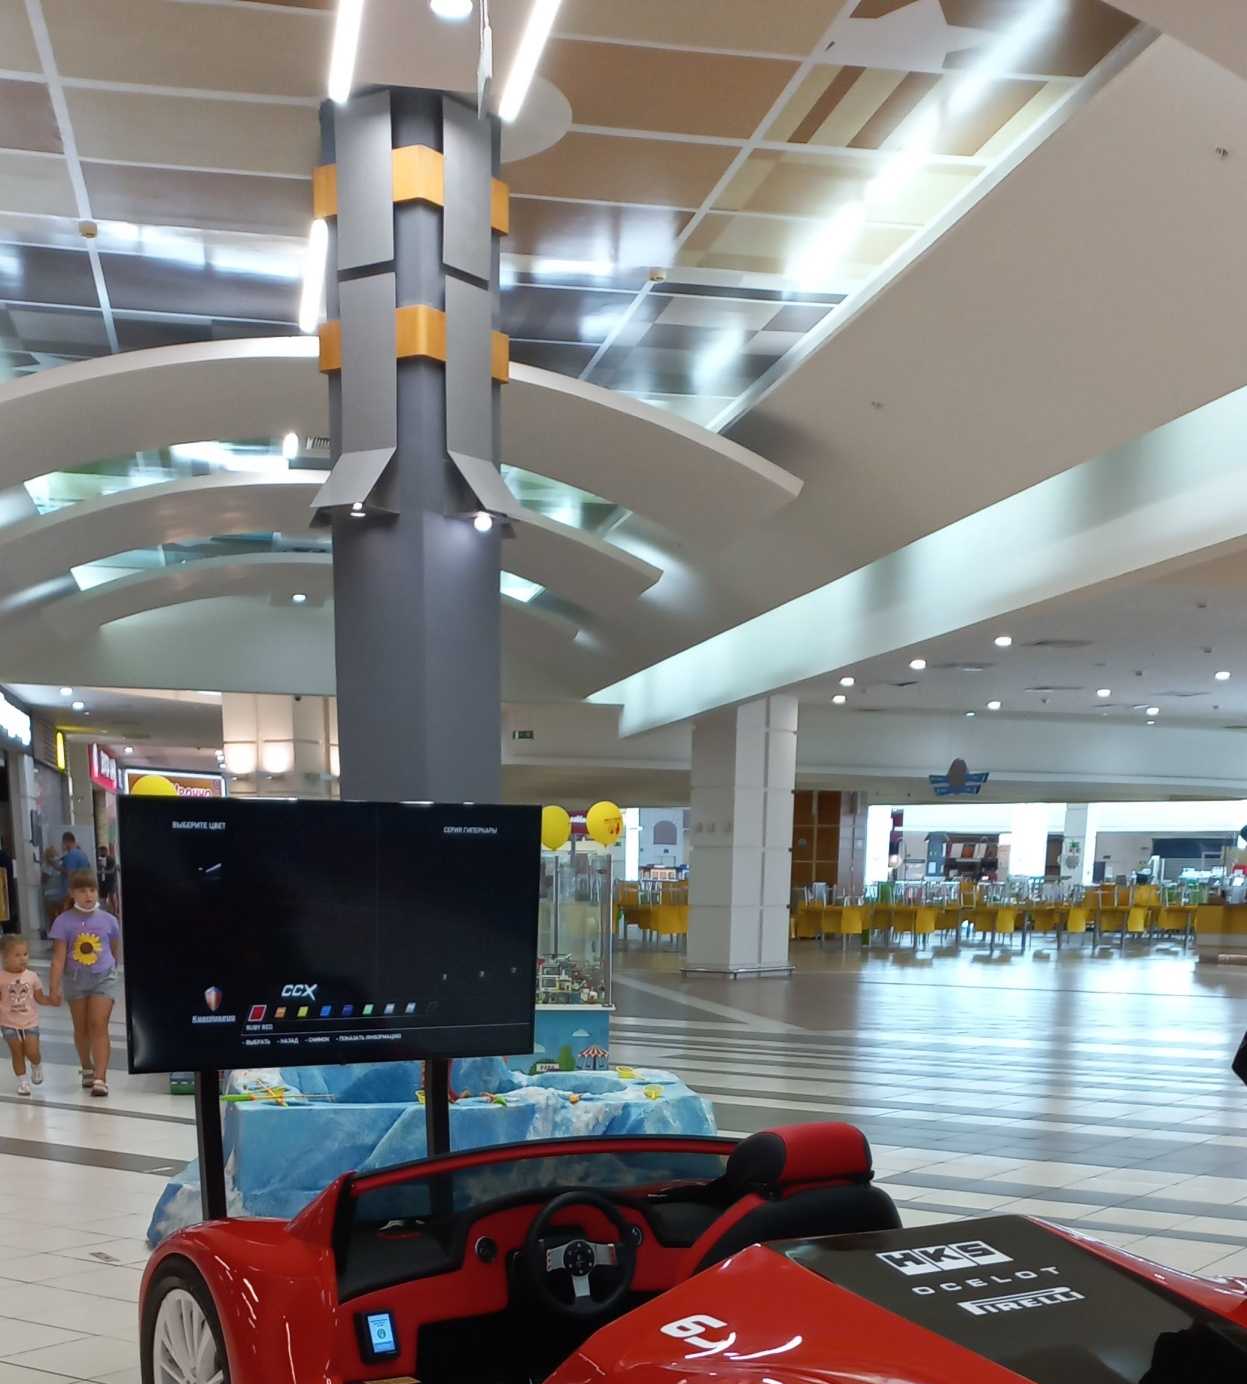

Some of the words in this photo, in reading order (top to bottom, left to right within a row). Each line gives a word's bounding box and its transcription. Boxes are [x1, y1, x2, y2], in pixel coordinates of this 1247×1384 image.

[281, 984, 318, 1001] CCX
[878, 1241, 1006, 1272] HKS
[911, 1266, 1060, 1295] OCELOT
[957, 1286, 1085, 1316] PIRELLI
